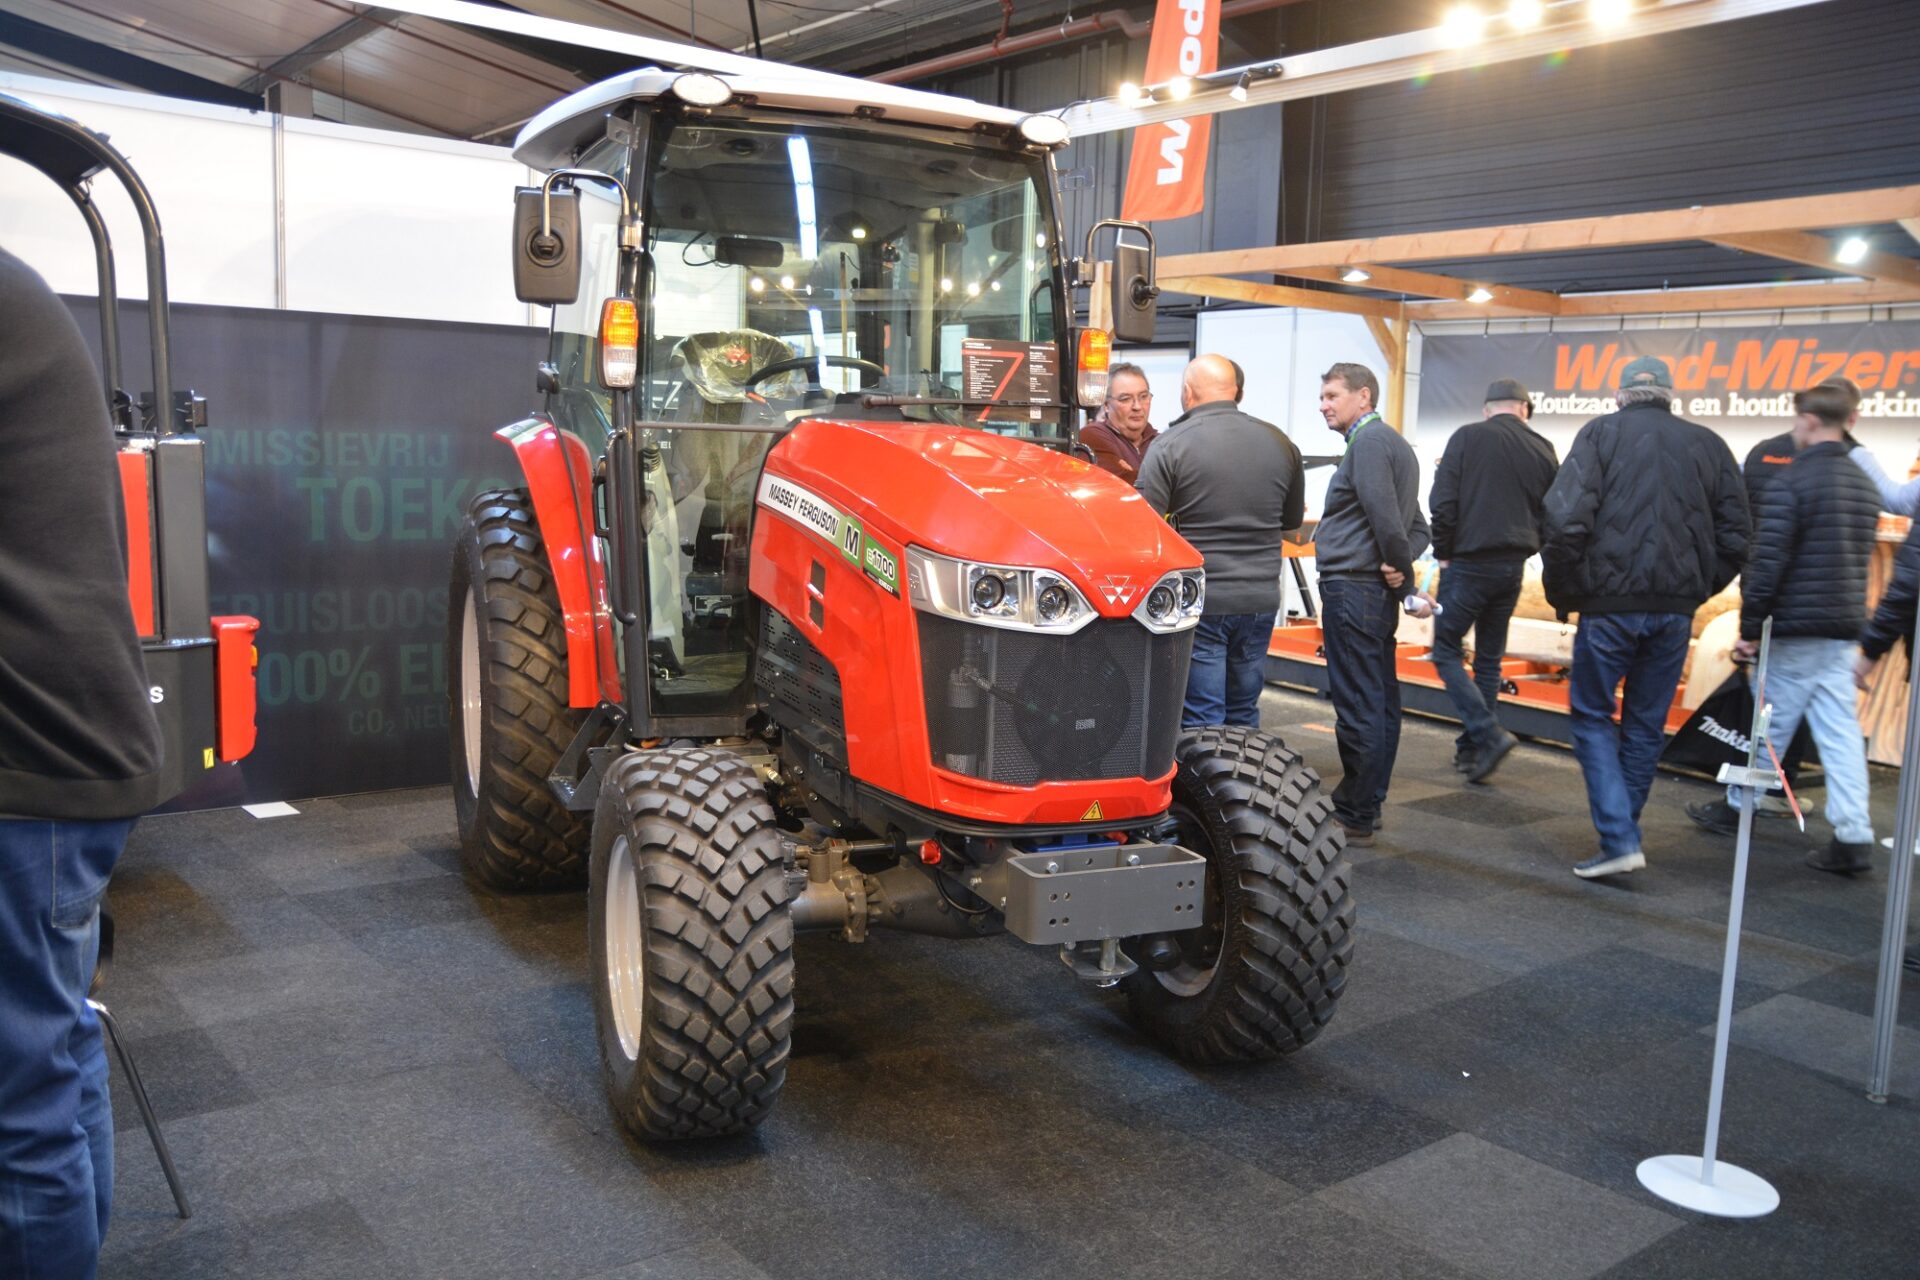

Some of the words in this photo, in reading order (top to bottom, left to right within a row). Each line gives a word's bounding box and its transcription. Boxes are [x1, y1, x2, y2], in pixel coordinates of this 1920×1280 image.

[1689, 397, 1722, 417] en
[296, 474, 528, 542] TOEK
[768, 483, 800, 511] MASSEY
[798, 498, 839, 537] FERGUSON
[843, 522, 861, 560] M
[210, 586, 450, 635] RUISLOOS
[257, 645, 382, 705] 00%
